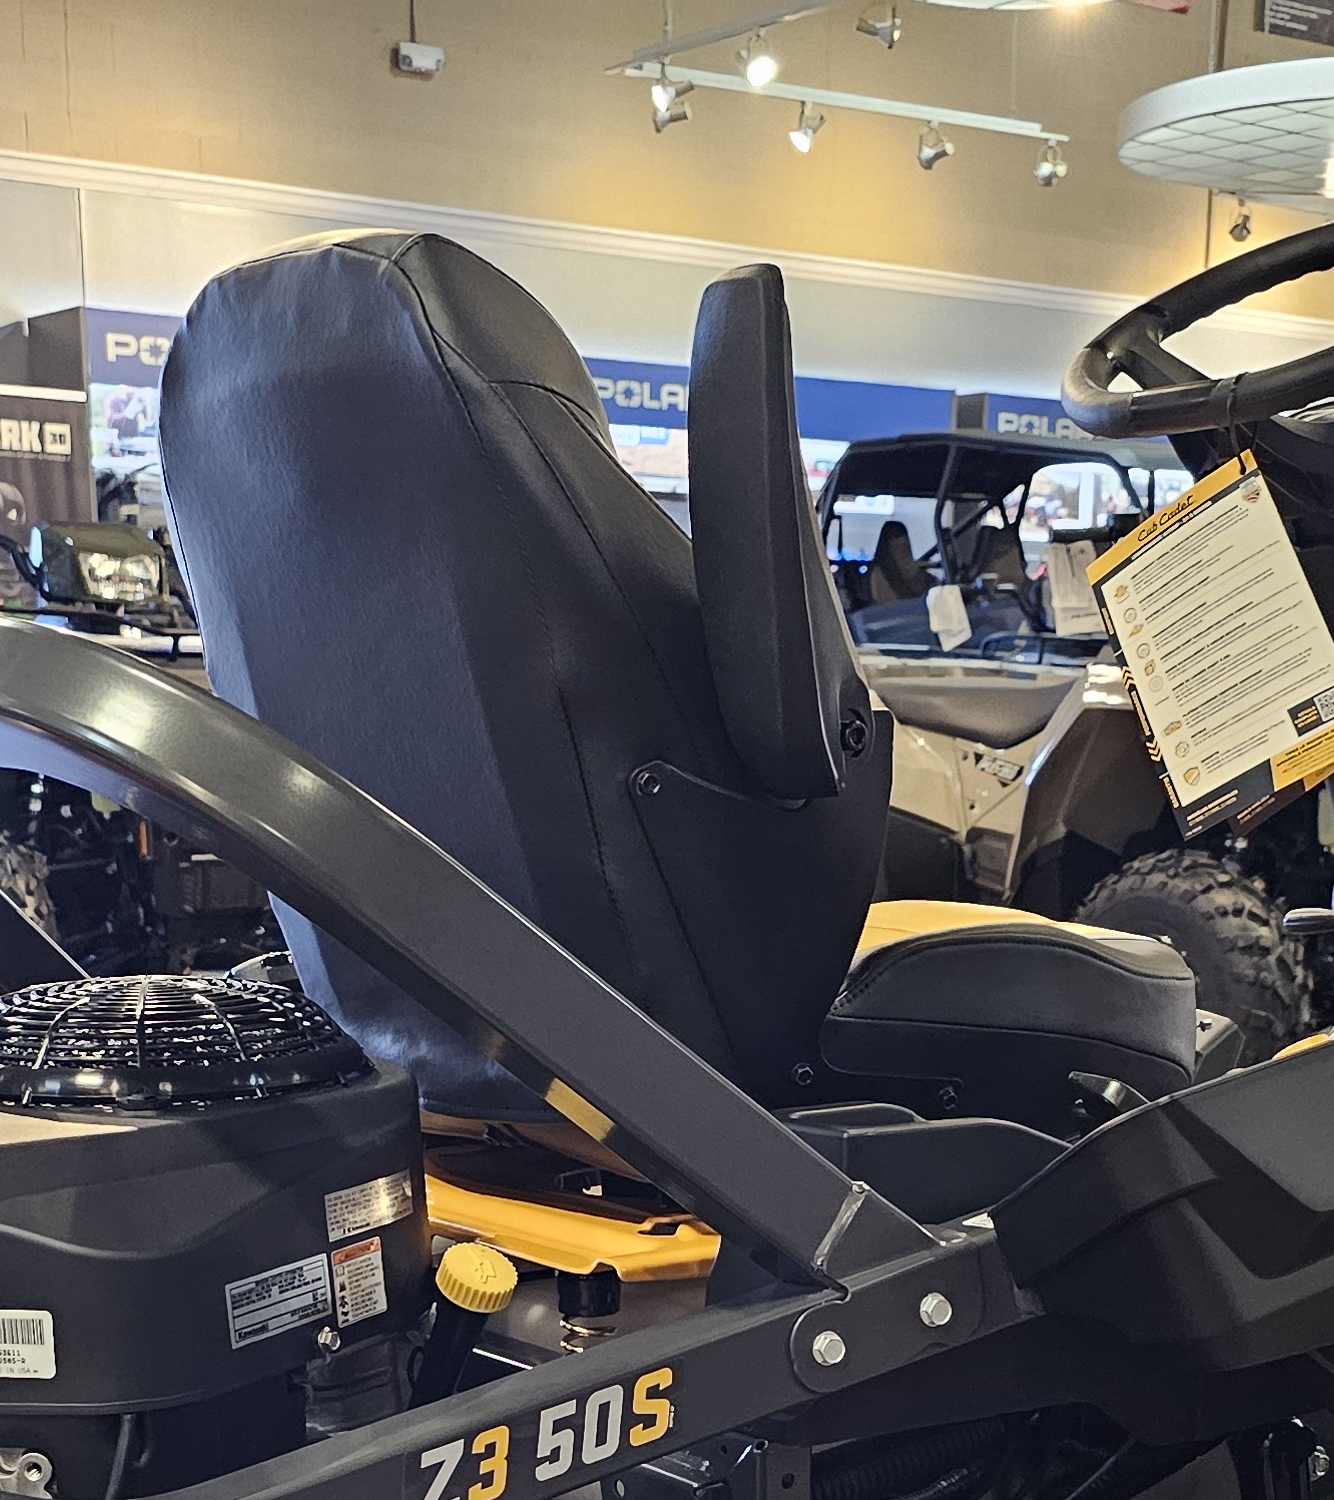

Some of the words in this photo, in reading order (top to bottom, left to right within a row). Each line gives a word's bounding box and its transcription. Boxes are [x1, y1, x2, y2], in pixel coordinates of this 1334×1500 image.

[1137, 521, 1158, 542] Cub
[1159, 494, 1194, 526] Cadet
[535, 1367, 674, 1482] 50S
